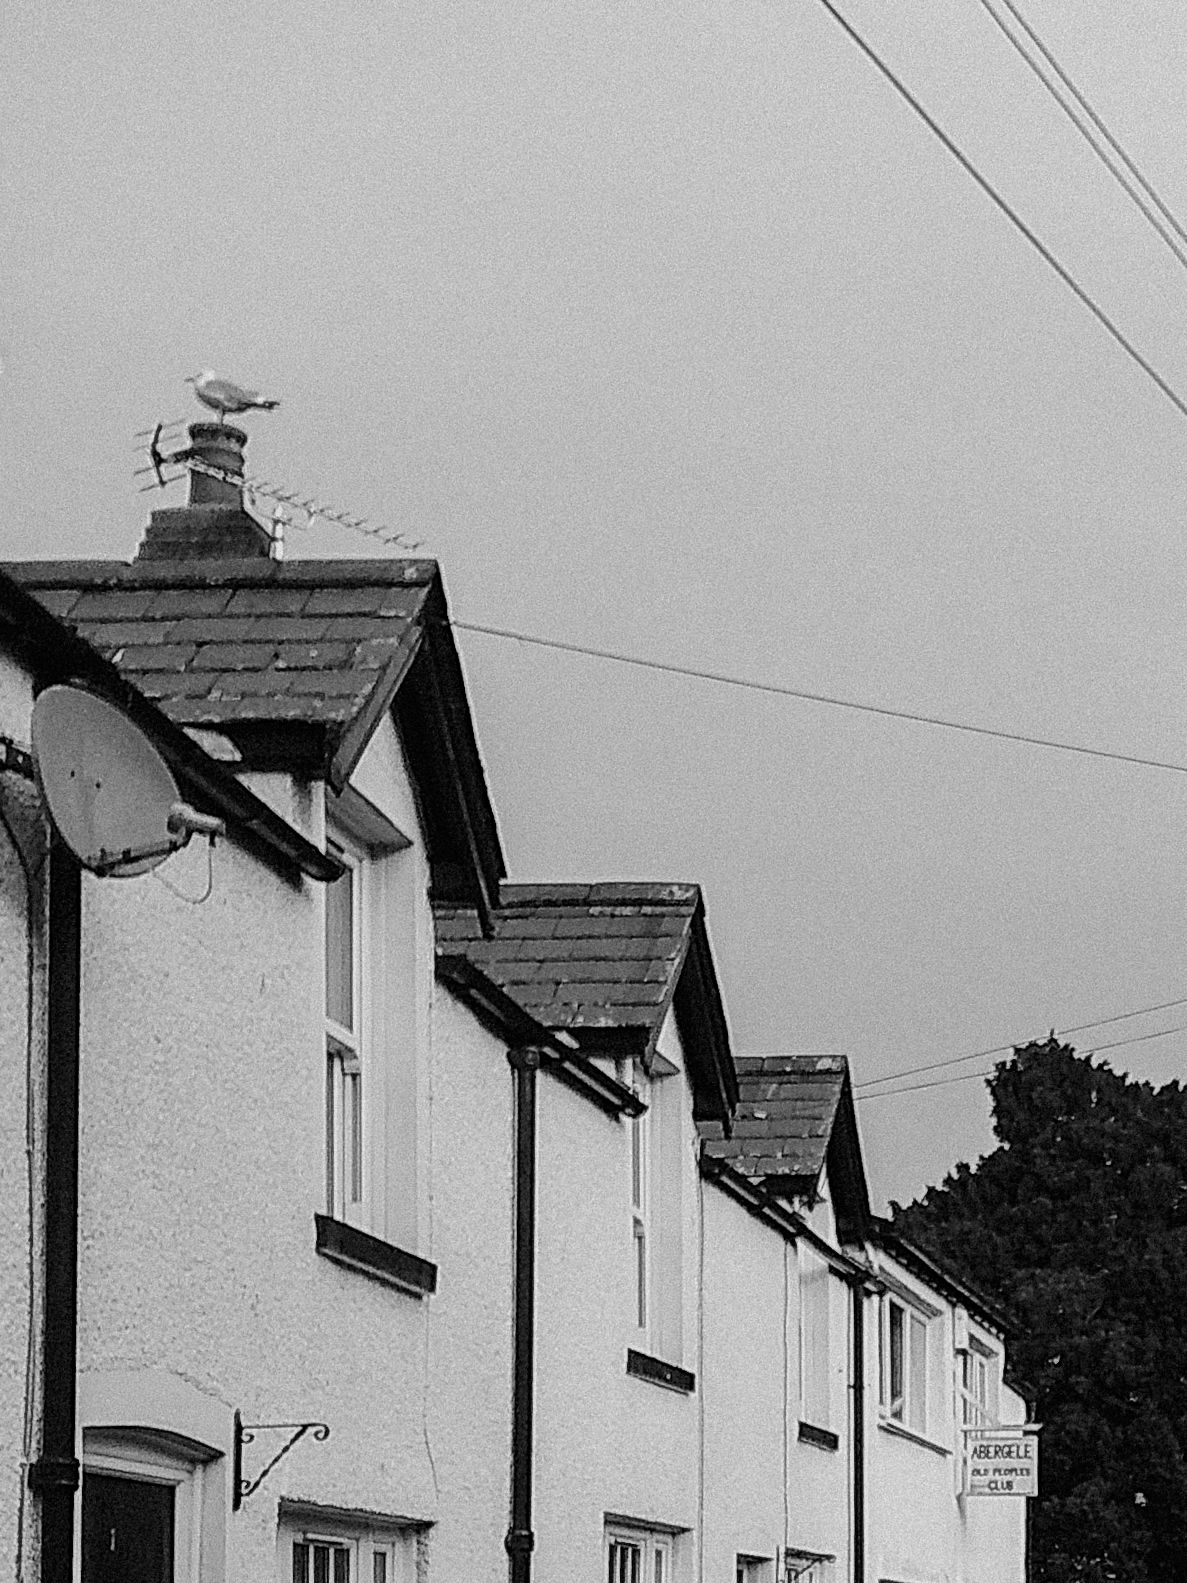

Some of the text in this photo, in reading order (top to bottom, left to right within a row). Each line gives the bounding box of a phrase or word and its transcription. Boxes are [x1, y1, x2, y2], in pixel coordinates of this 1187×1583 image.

[971, 1443, 1032, 1460] ABERGELE
[971, 1467, 989, 1477] OLD
[987, 1480, 1014, 1491] CLUB
